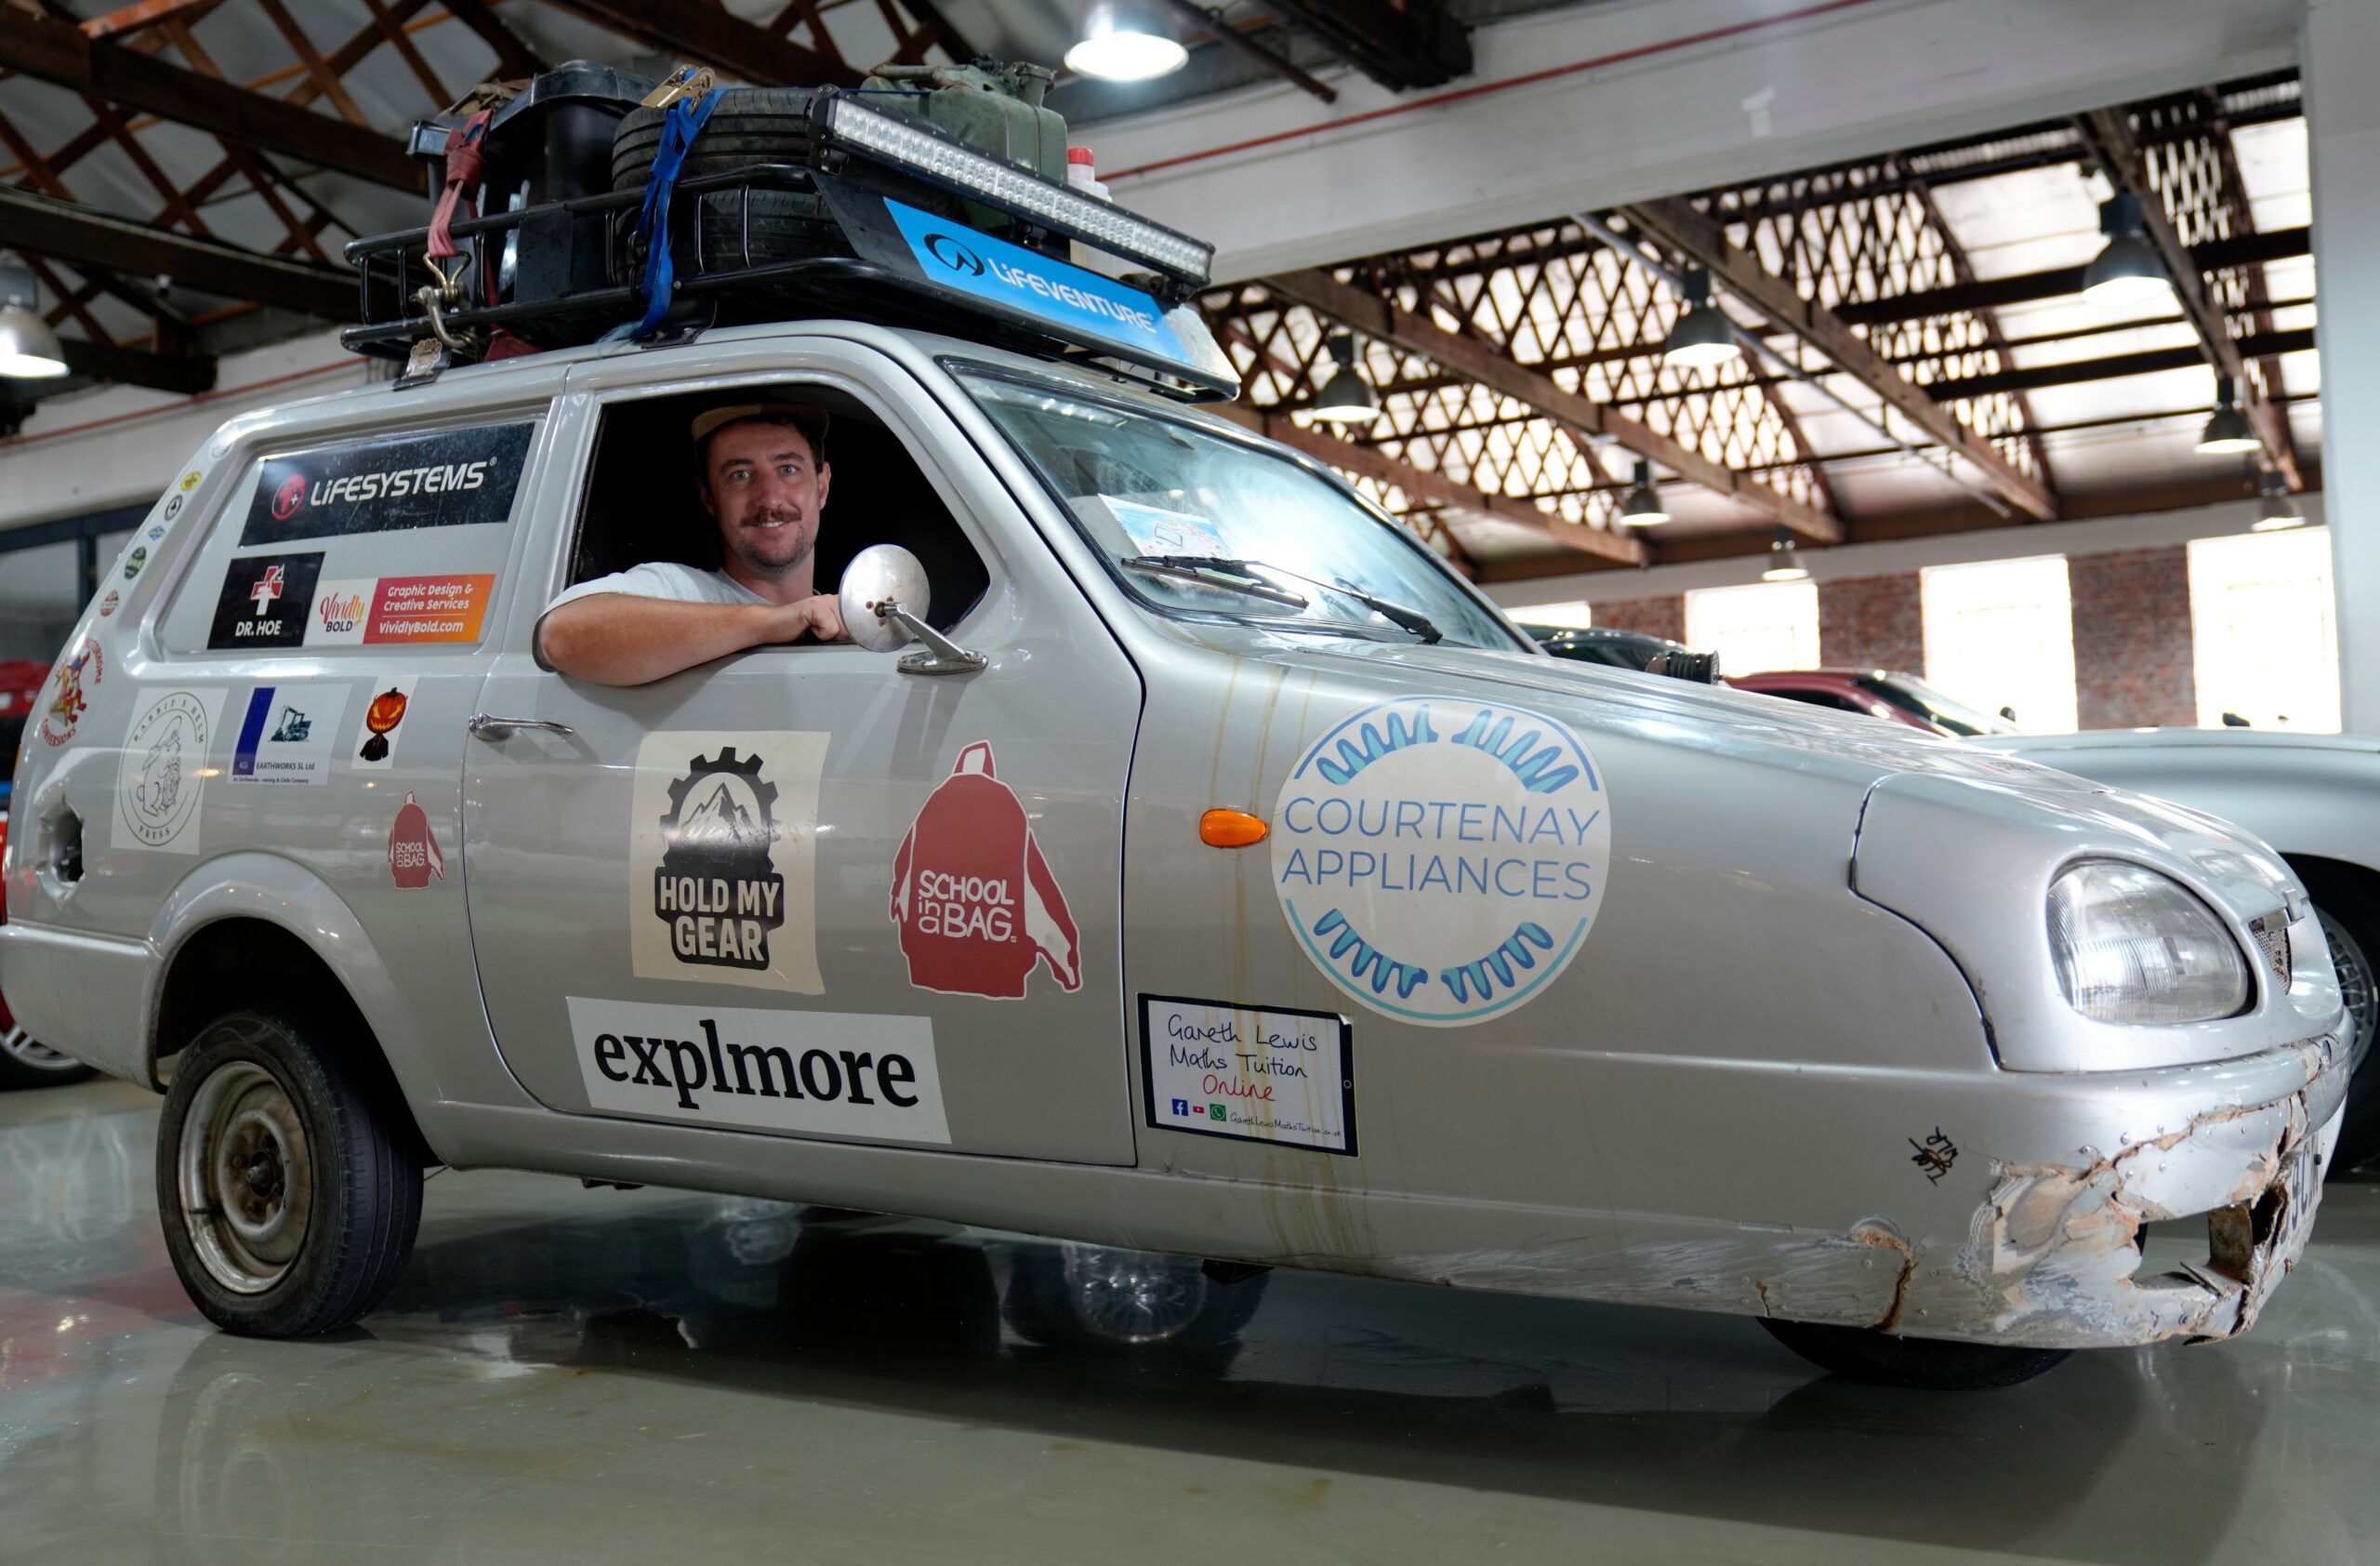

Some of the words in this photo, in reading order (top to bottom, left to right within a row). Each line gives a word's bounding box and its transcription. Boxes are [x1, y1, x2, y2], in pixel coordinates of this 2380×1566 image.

[384, 598, 425, 612] Creative
[426, 598, 469, 610] Services
[388, 583, 426, 598] Graphic
[428, 582, 463, 597] Design
[465, 584, 473, 594] &
[320, 592, 365, 627] Vividly
[235, 620, 255, 637] DR.
[256, 619, 283, 636] HOE
[325, 620, 353, 633] BOLD
[379, 620, 464, 636] VividlyBold.com
[256, 762, 297, 770] EARTHWORKS
[1285, 797, 1601, 847] COURTENAY
[396, 842, 425, 854] SCHOOL
[404, 853, 425, 868] BAG
[919, 869, 1015, 906] SCHOOL
[1281, 848, 1592, 901] APPLIANCES
[660, 876, 729, 913] HOLD
[737, 880, 780, 917] MY
[919, 896, 941, 917] in
[919, 915, 940, 935] a
[944, 902, 1012, 942] BAG
[675, 915, 764, 962] GEAR
[1168, 1014, 1241, 1043] Gareth
[1256, 1025, 1317, 1052] Lewis
[594, 1019, 919, 1110] explmore
[1170, 1043, 1228, 1070] Maths
[1236, 1053, 1307, 1079] Tuition
[1203, 1074, 1276, 1102] Online
